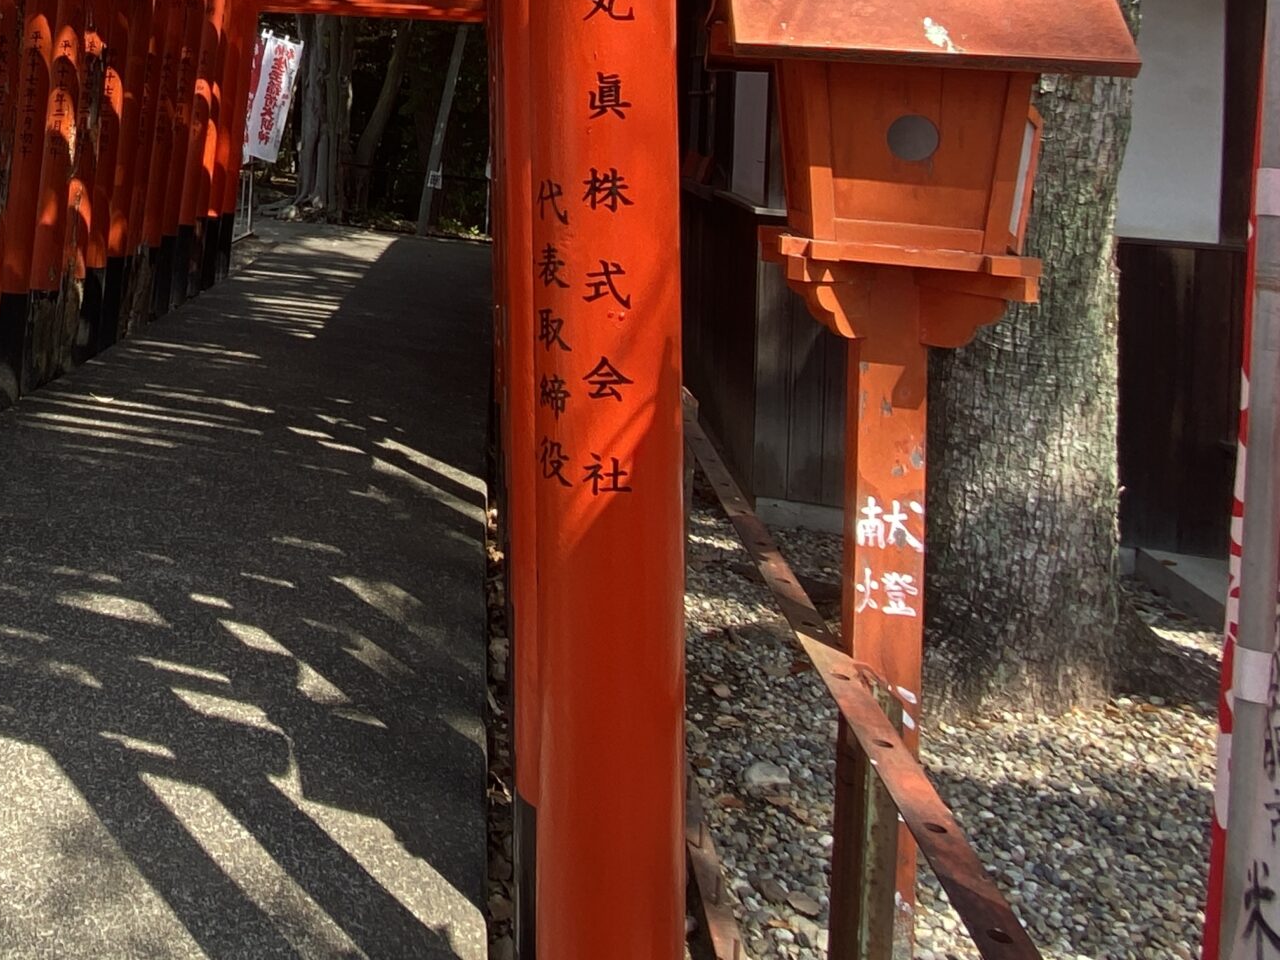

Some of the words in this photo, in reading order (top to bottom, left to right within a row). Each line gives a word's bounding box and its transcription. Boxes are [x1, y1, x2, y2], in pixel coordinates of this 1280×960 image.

[534, 177, 574, 489] 代表取締役
